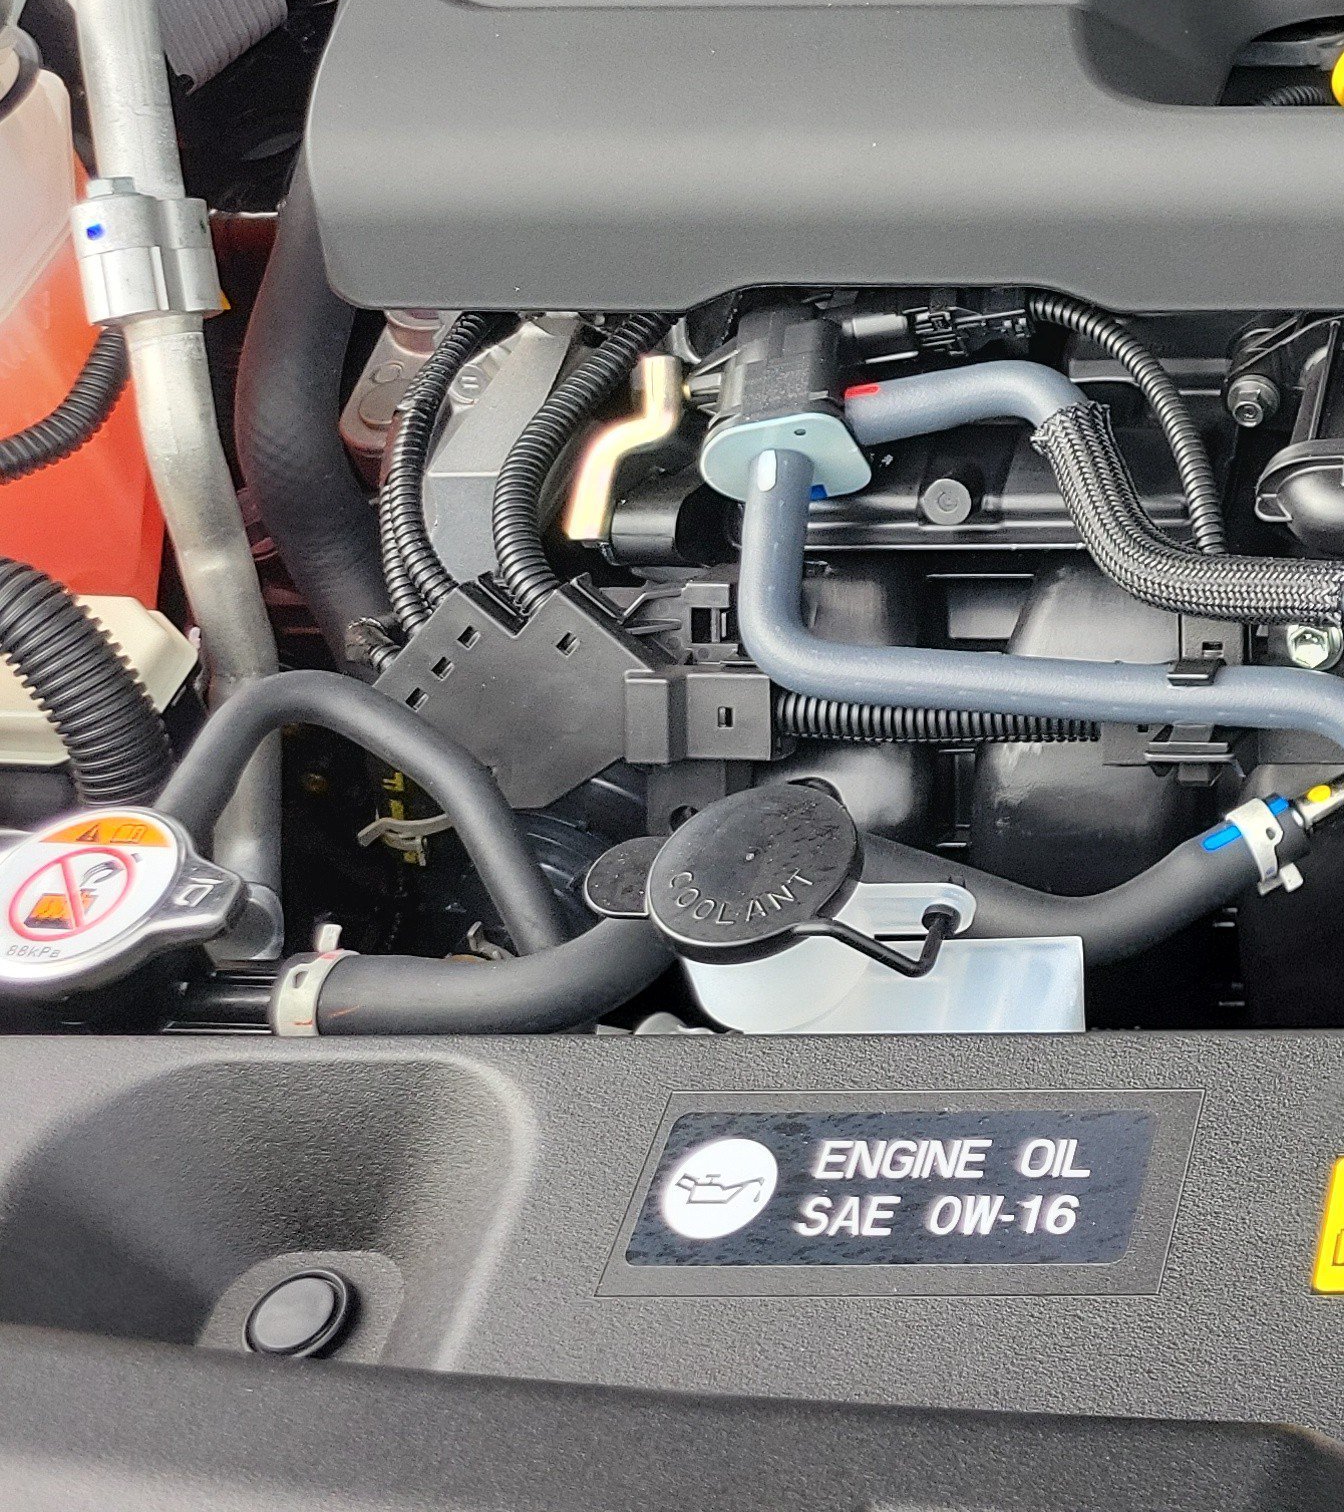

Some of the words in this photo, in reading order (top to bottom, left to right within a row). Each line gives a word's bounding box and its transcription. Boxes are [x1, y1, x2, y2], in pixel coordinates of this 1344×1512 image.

[669, 867, 813, 925] COOLANT
[6, 944, 61, 958] 88kPa
[814, 1138, 993, 1180] ENGINE
[1018, 1138, 1092, 1180] OIL
[797, 1195, 901, 1236] SAE
[928, 1194, 1080, 1236] 0W-16
